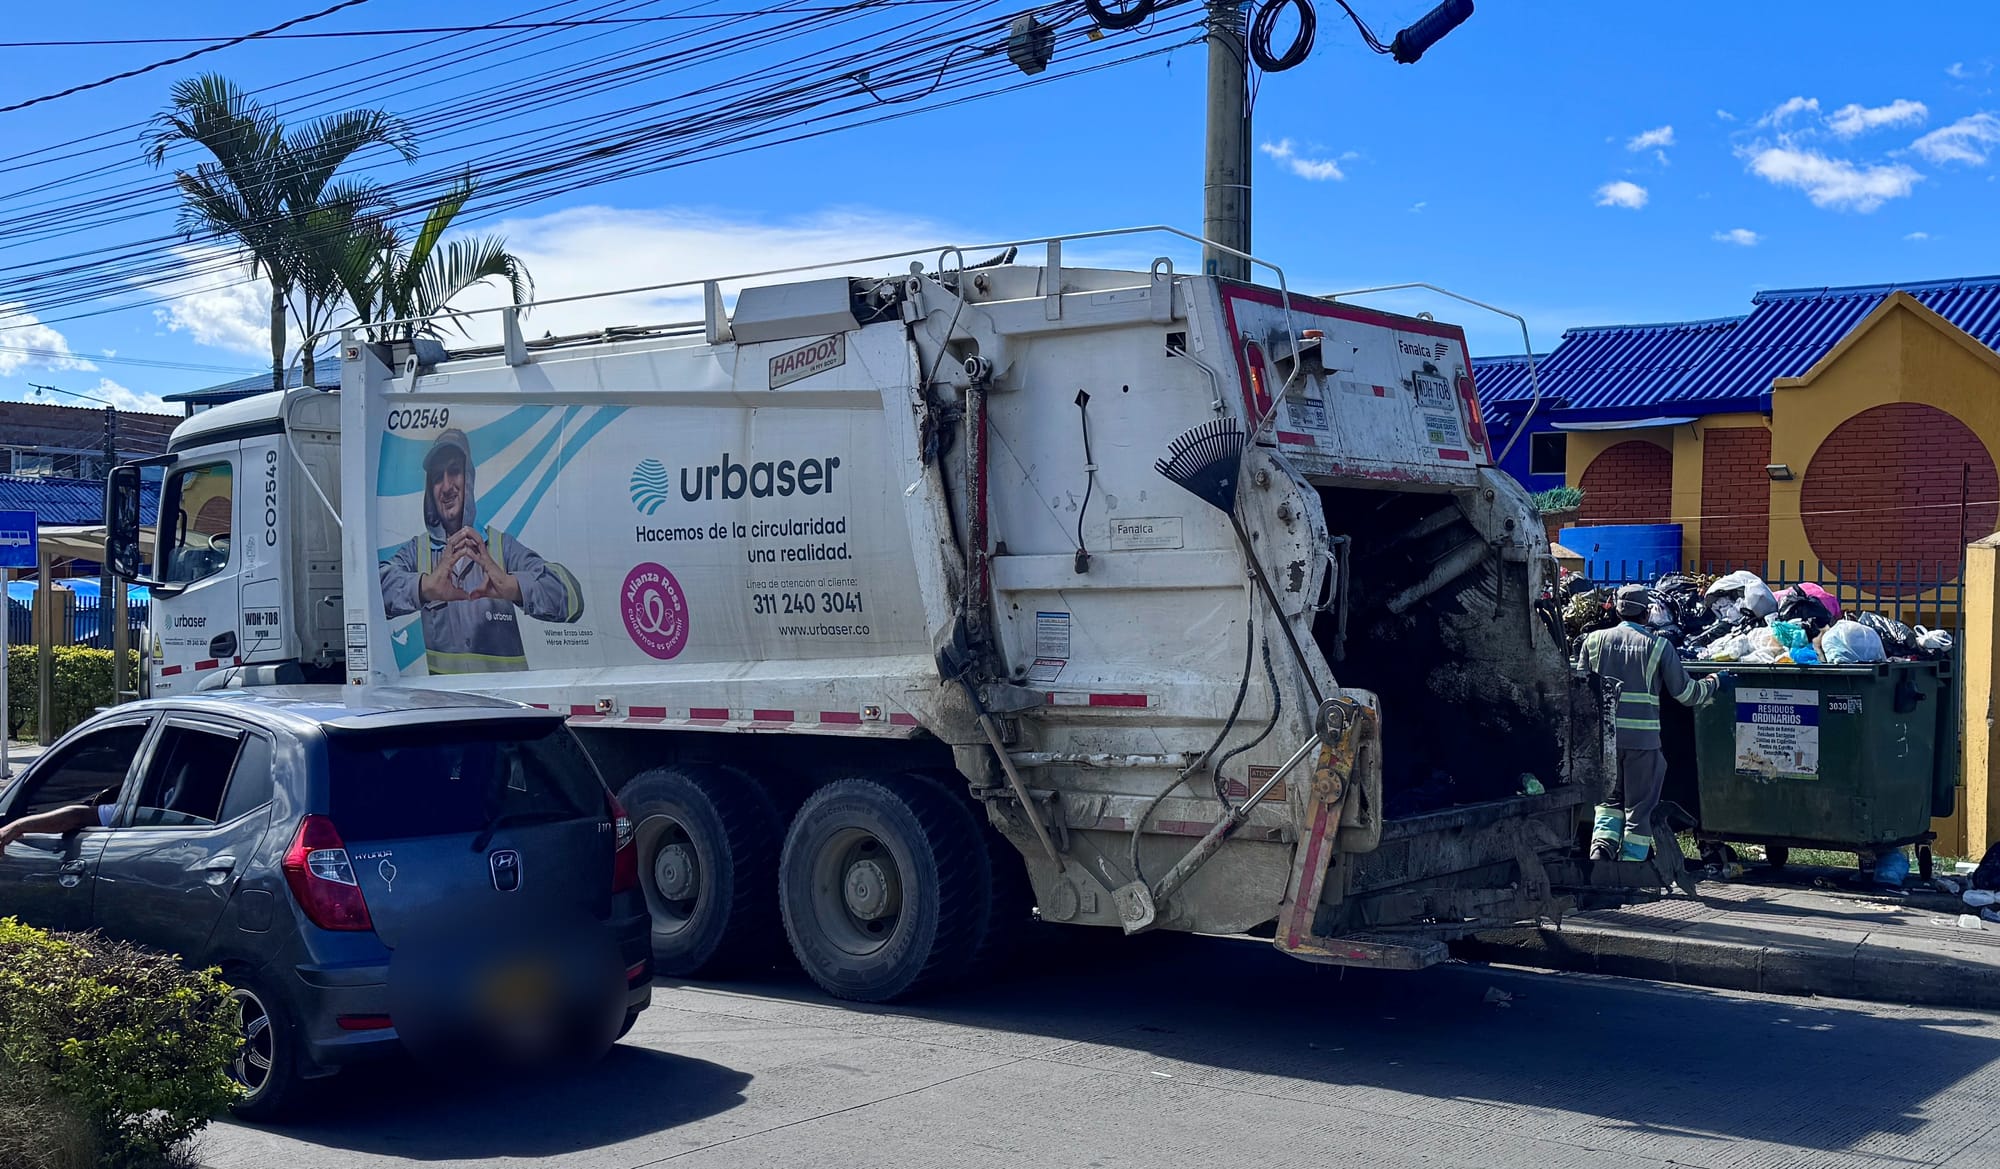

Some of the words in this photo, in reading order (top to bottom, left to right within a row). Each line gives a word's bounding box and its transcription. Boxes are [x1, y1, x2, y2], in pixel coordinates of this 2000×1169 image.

[773, 339, 838, 376] HARDOX
[1398, 339, 1431, 358] Fanalca
[1433, 382, 1450, 400] 708
[388, 408, 449, 430] CO2549
[680, 453, 840, 502] urbaser
[265, 450, 277, 547] CO2549
[636, 526, 704, 542] Hacemos
[708, 523, 727, 539] de
[733, 521, 746, 538] la
[751, 516, 846, 537] circularidad
[1117, 524, 1153, 534] Fanalca
[748, 549, 775, 563] una
[781, 542, 852, 561] realidad.
[627, 572, 659, 603] Alianza
[661, 576, 681, 611] Rosa
[768, 579, 778, 588] de
[818, 578, 825, 587] al
[828, 577, 857, 587] cliente:
[753, 593, 777, 614] 311
[782, 592, 816, 614] 240
[821, 591, 863, 613] 3041
[174, 614, 207, 628] urbaser
[779, 623, 870, 636] www.urbaser.co
[1758, 704, 1795, 714] RESIDUOS
[1829, 702, 1847, 710] 3030
[1752, 713, 1801, 725] ORDINARIOS
